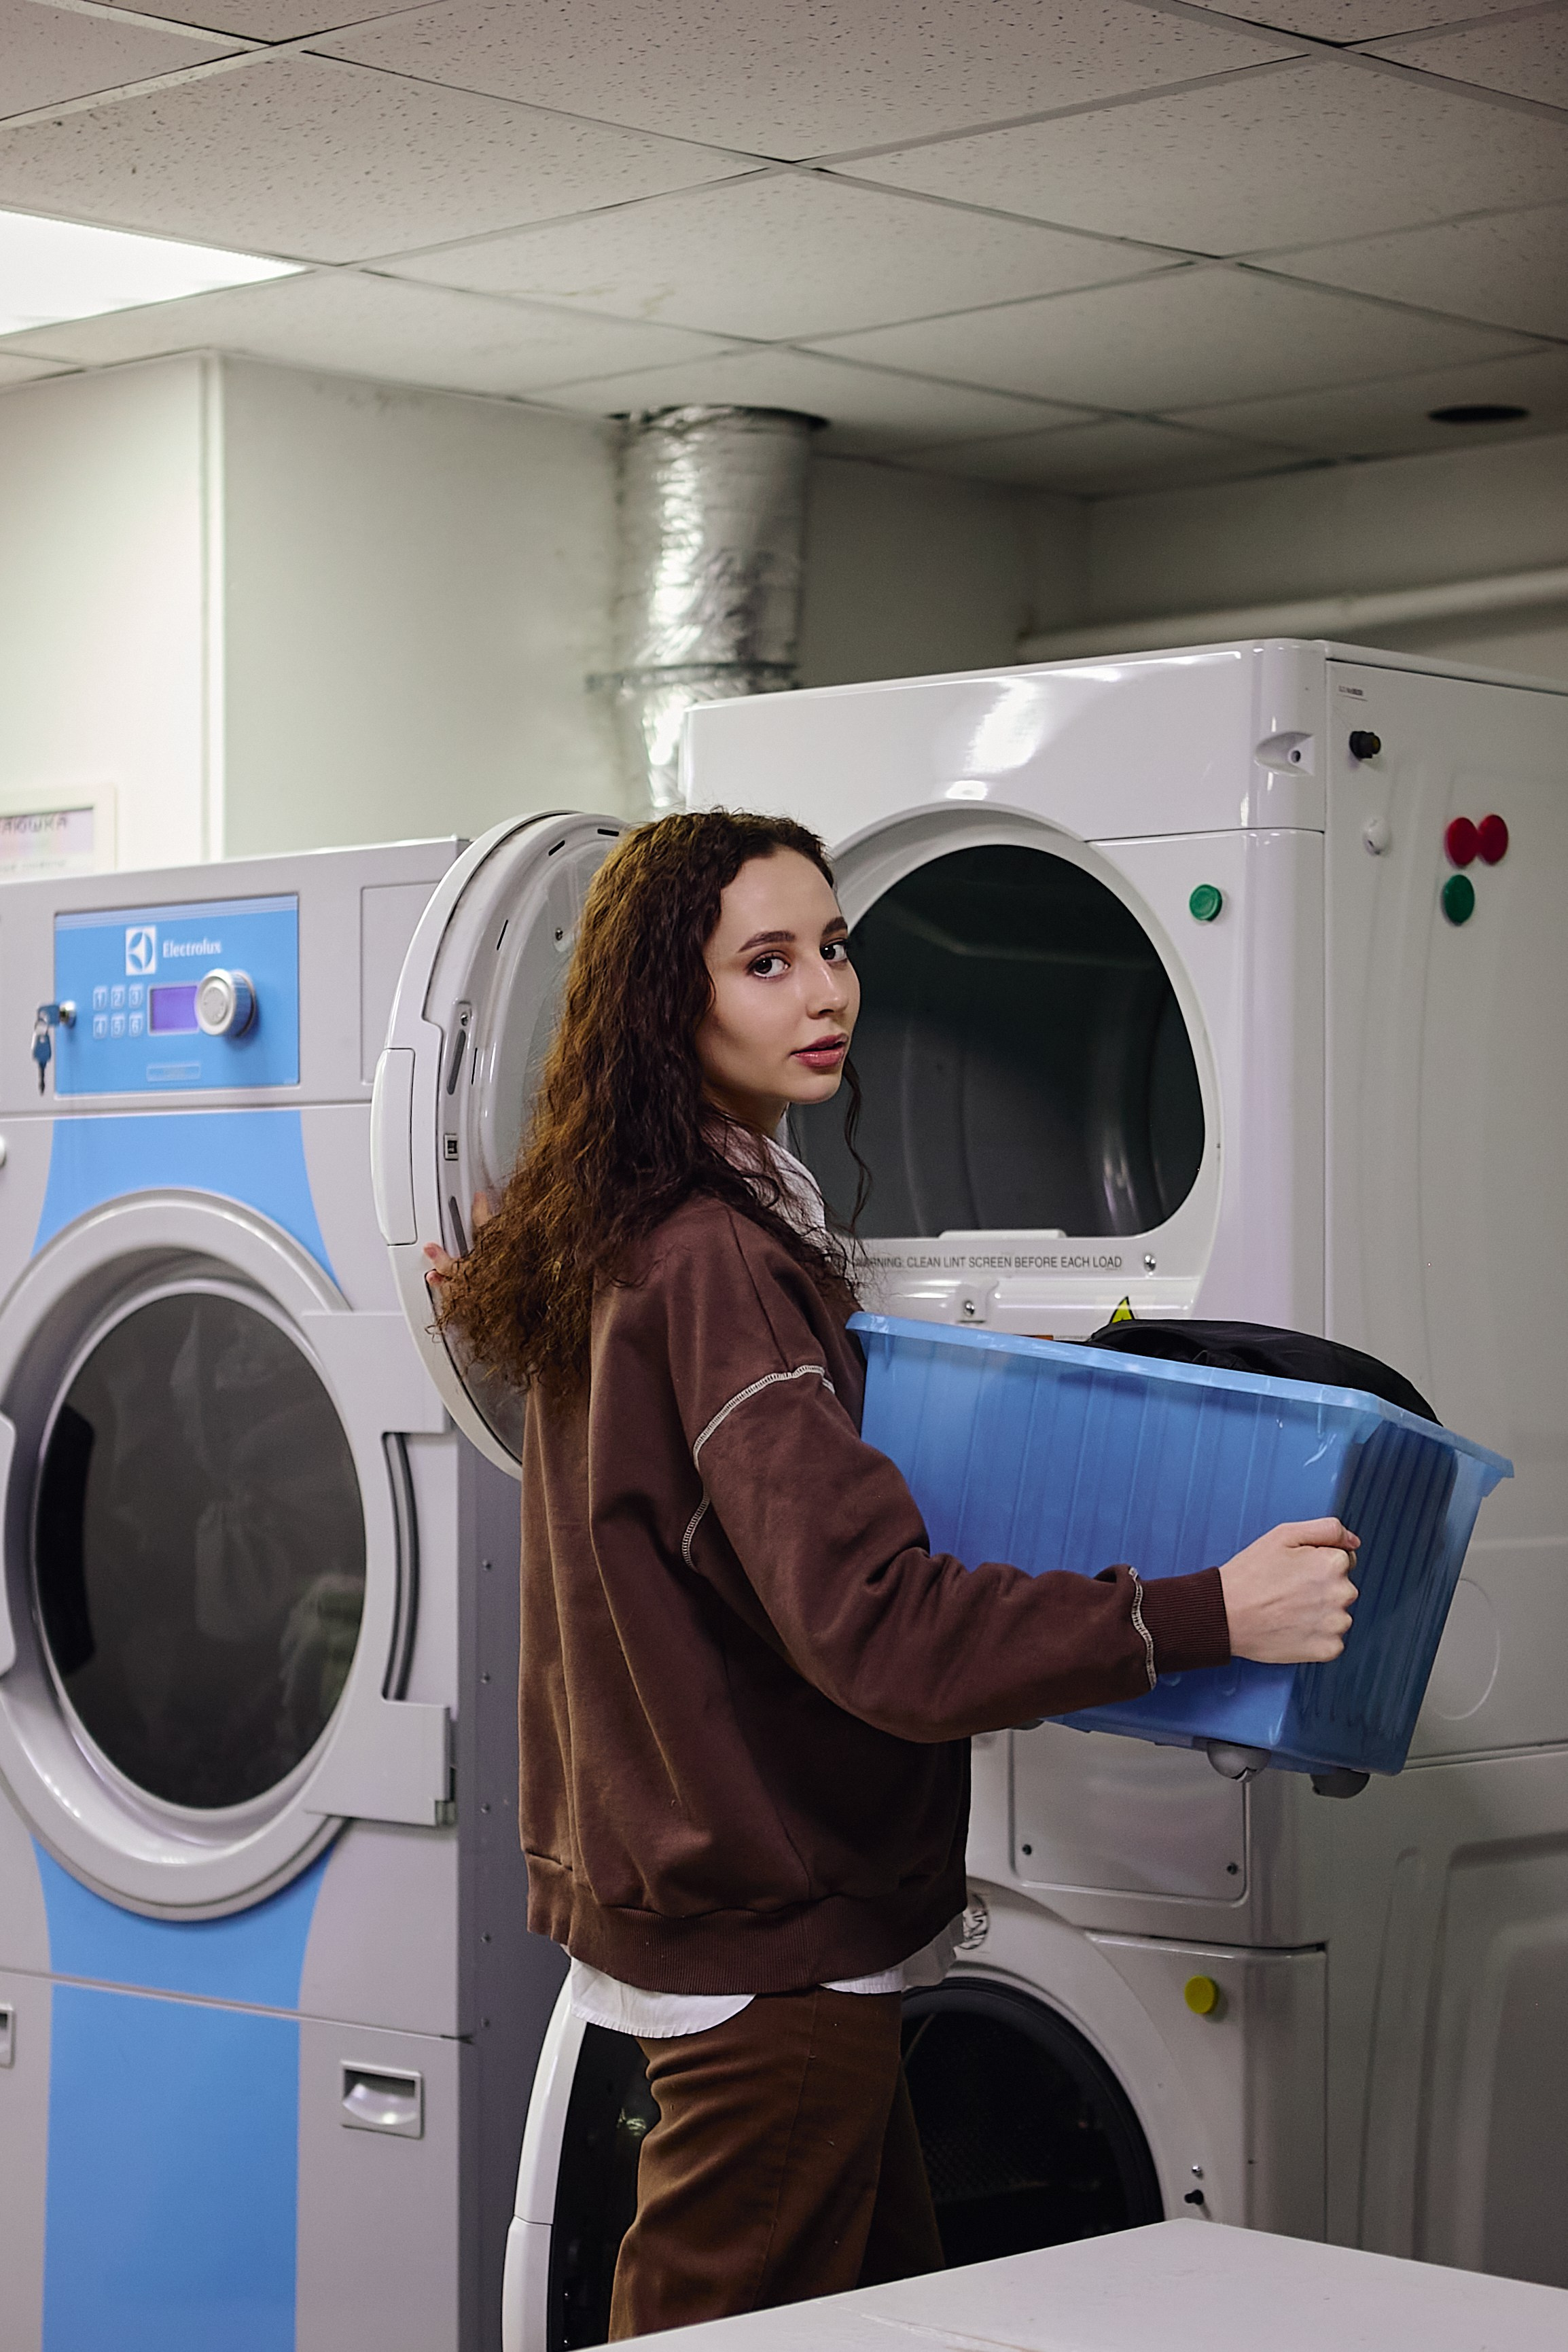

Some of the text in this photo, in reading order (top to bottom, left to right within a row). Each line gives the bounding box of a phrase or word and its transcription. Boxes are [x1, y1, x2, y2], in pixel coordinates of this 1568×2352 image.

[163, 938, 221, 958] Electrolux
[907, 1257, 940, 1268] CLEAN
[944, 1257, 964, 1268] LINT
[968, 1257, 1012, 1268] SCREEN
[1014, 1257, 1057, 1268] BEFORE
[1061, 1257, 1089, 1268] EACH
[1093, 1257, 1122, 1268] LOAD
